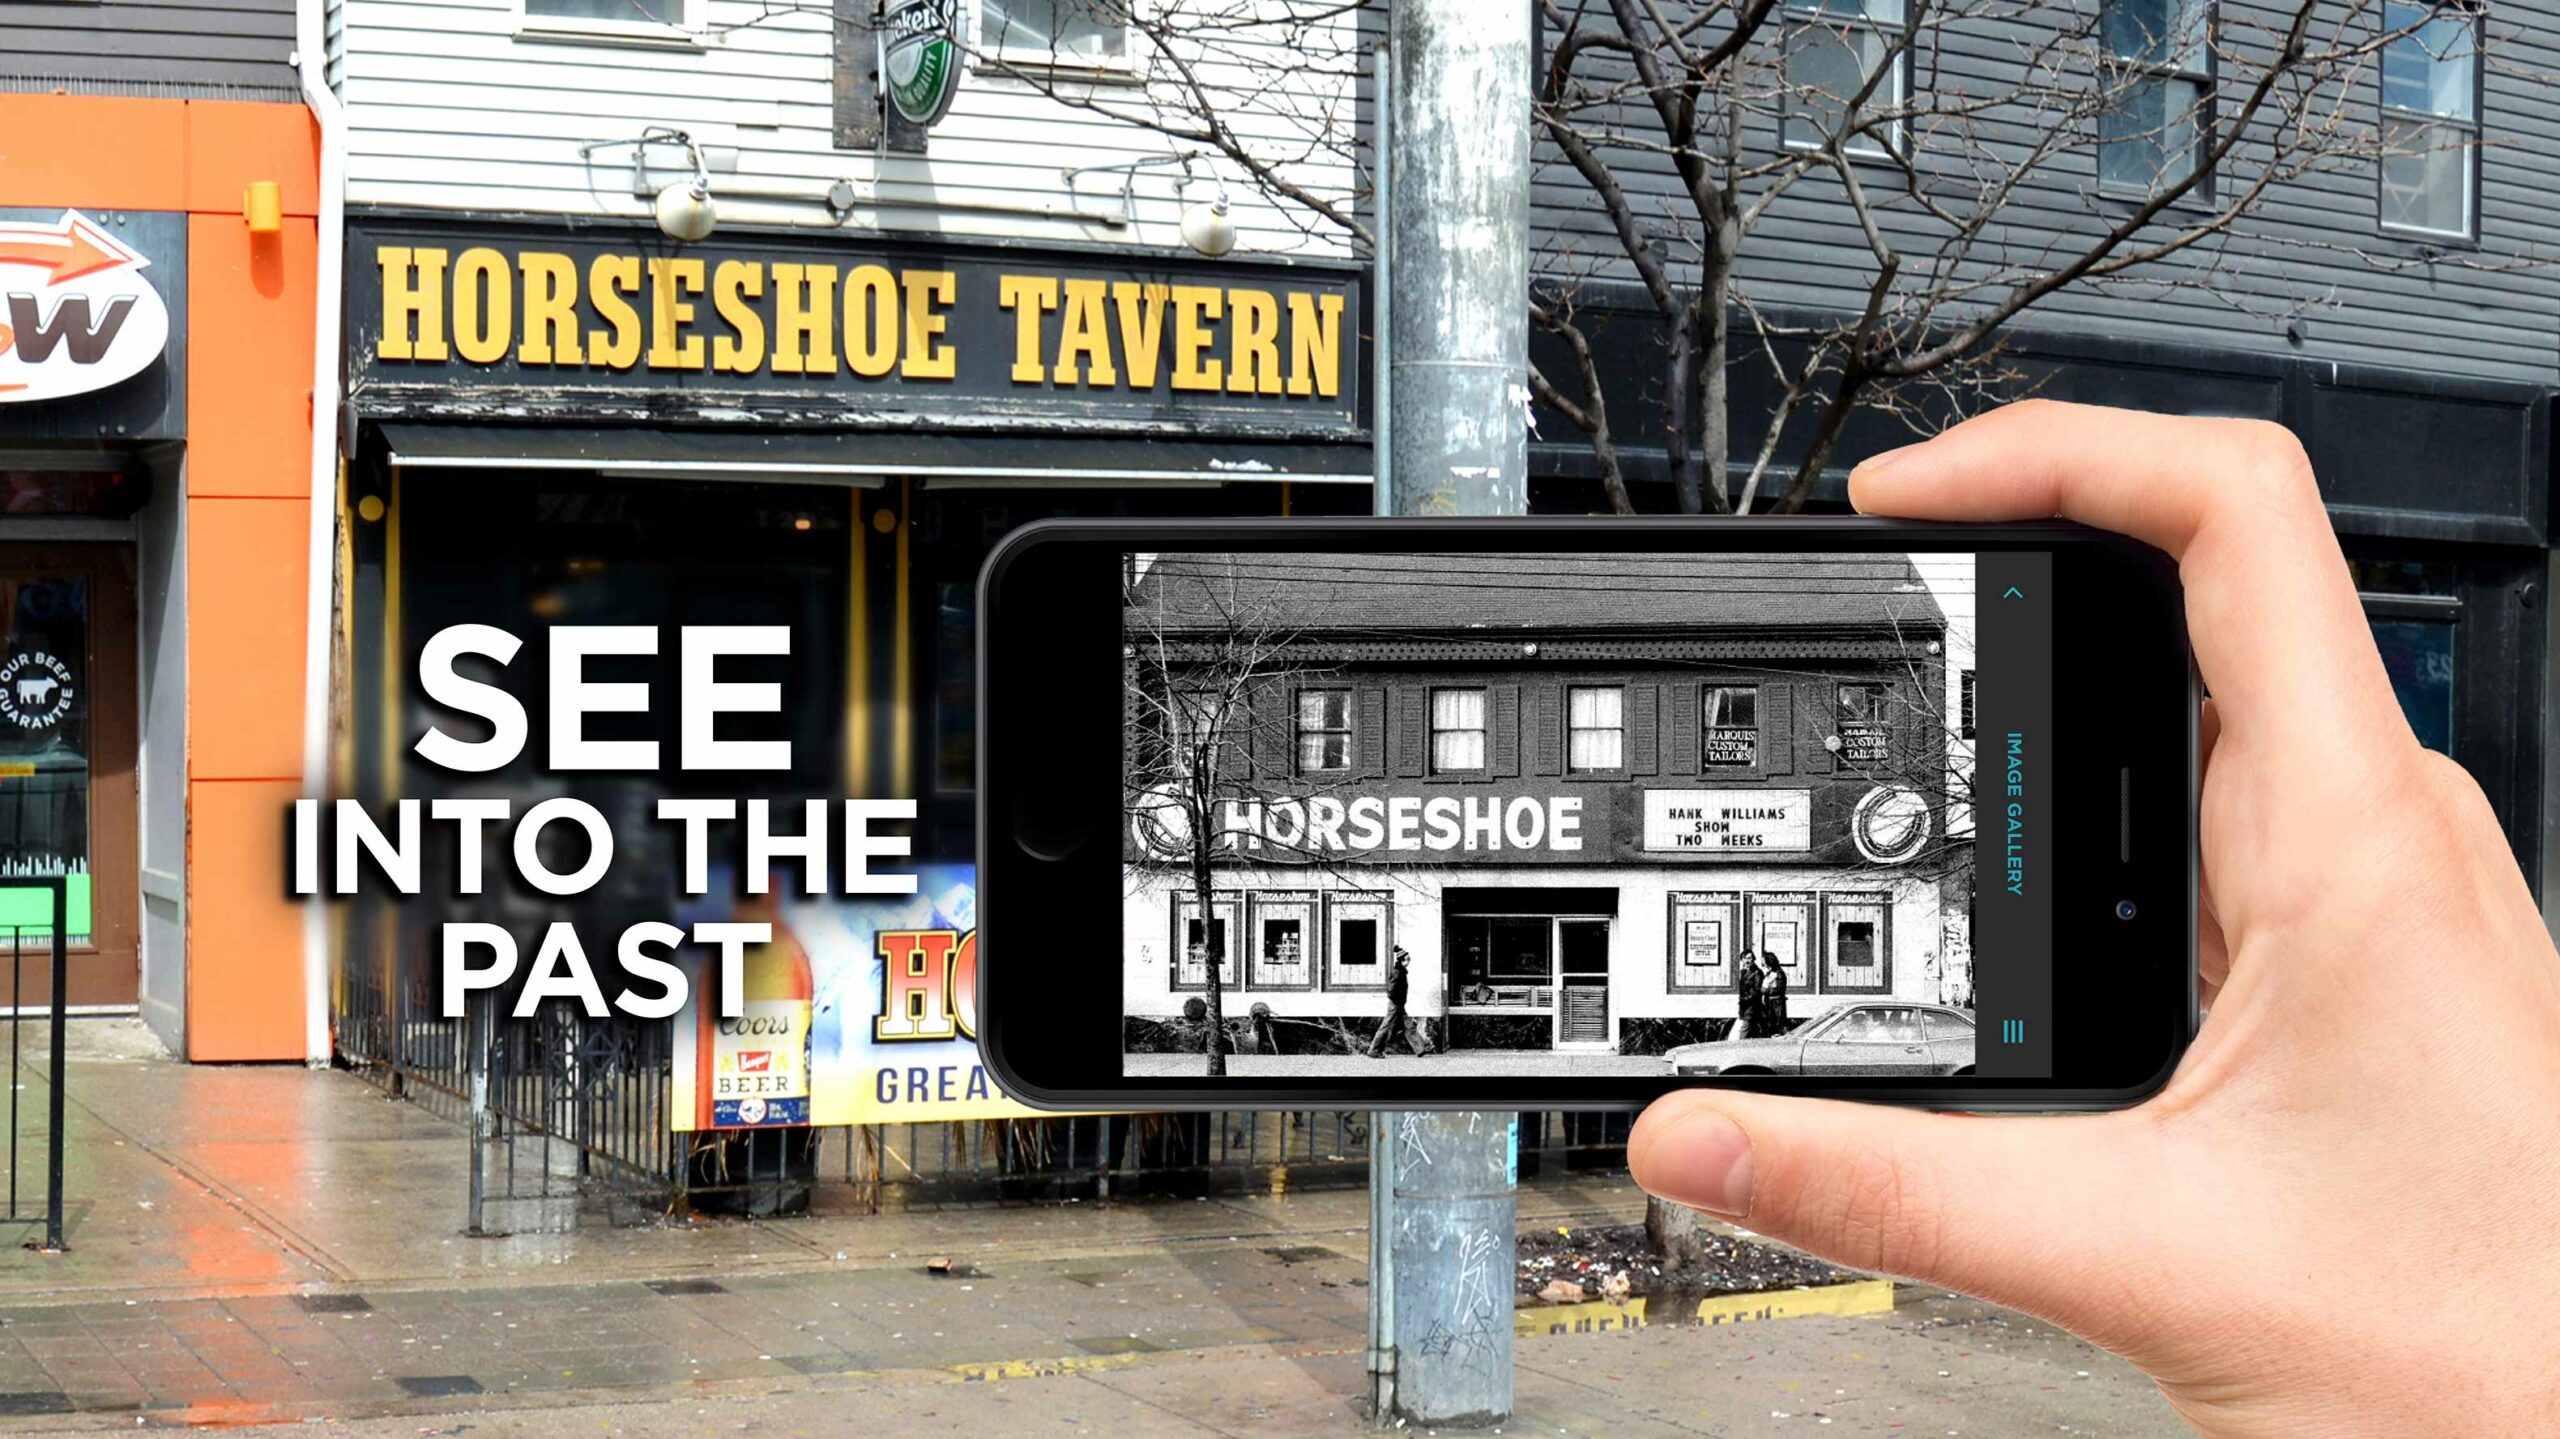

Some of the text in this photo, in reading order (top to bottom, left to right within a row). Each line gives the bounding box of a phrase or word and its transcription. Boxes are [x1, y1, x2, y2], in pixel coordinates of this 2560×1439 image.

[913, 50, 938, 101] QUALITY
[377, 246, 1344, 396] HORSESHOE TAVERN
[0, 291, 138, 365] W
[0, 652, 72, 682] OUR BEEF
[0, 688, 73, 730] GUARANTEE
[1708, 730, 1755, 741] MARQUIS
[1708, 741, 1748, 751] CUSTOM
[1708, 751, 1751, 761] TAILORS
[1669, 808, 1786, 819] HANK WILLIAMS
[2007, 732, 2023, 896] IMAGE GALLERY
[1224, 797, 1583, 851] HORSESHOE
[1695, 822, 1730, 833] SHOW
[1676, 834, 1764, 846] TWO WEEKS
[1179, 890, 1236, 902] Horshoe
[1256, 890, 1311, 902] Horseshoe
[1331, 890, 1387, 902] Horsesh
[1676, 892, 1732, 903] Horseshoe
[1752, 892, 1807, 903] Horseshoe
[719, 1076, 788, 1093] BEER
[876, 1065, 1008, 1104] GREA
